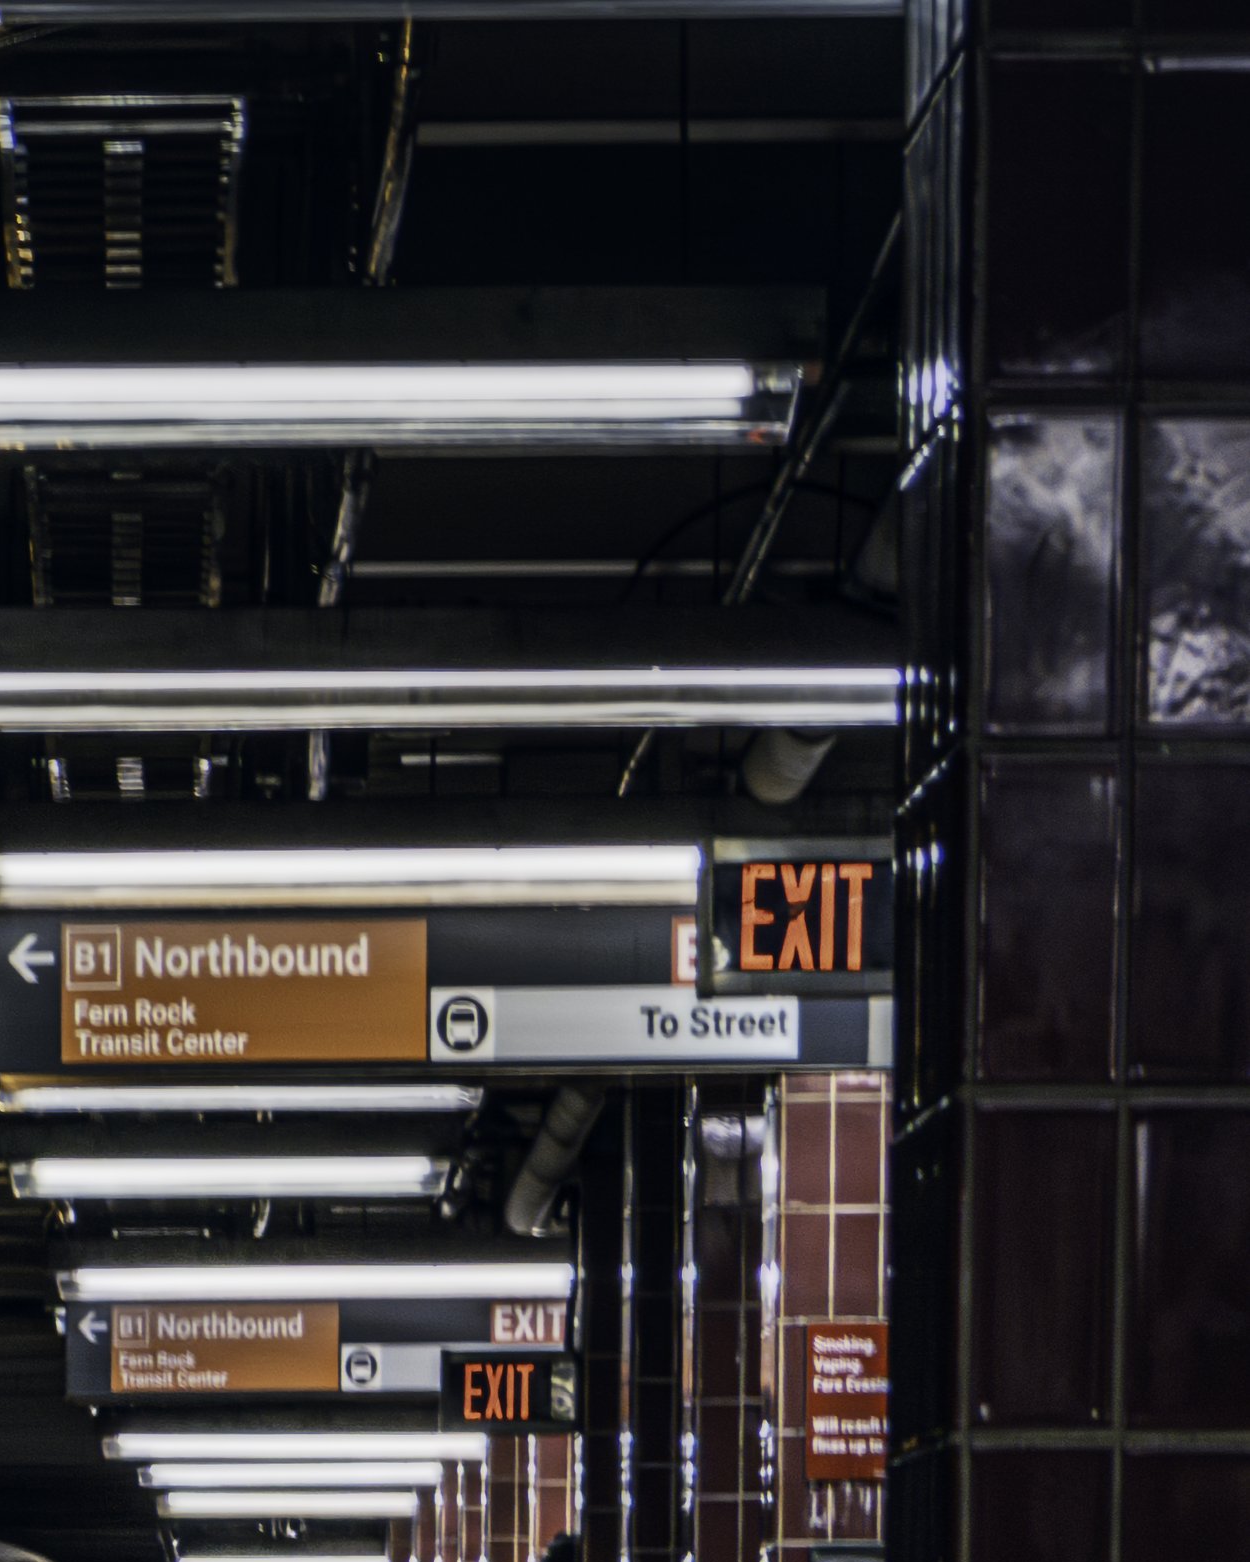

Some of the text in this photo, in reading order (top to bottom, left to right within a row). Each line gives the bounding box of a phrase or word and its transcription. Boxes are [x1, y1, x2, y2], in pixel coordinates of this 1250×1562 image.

[741, 863, 873, 970] EXIT
[74, 932, 369, 979] B1 Northbound
[74, 997, 197, 1027] Fern Rock
[640, 1006, 788, 1039] To Street
[75, 1029, 249, 1057] Transit Center
[157, 1311, 304, 1340] Northbound
[494, 1304, 566, 1341] EXIT
[121, 1370, 228, 1389] Transit Center
[464, 1363, 535, 1421] EXIT
